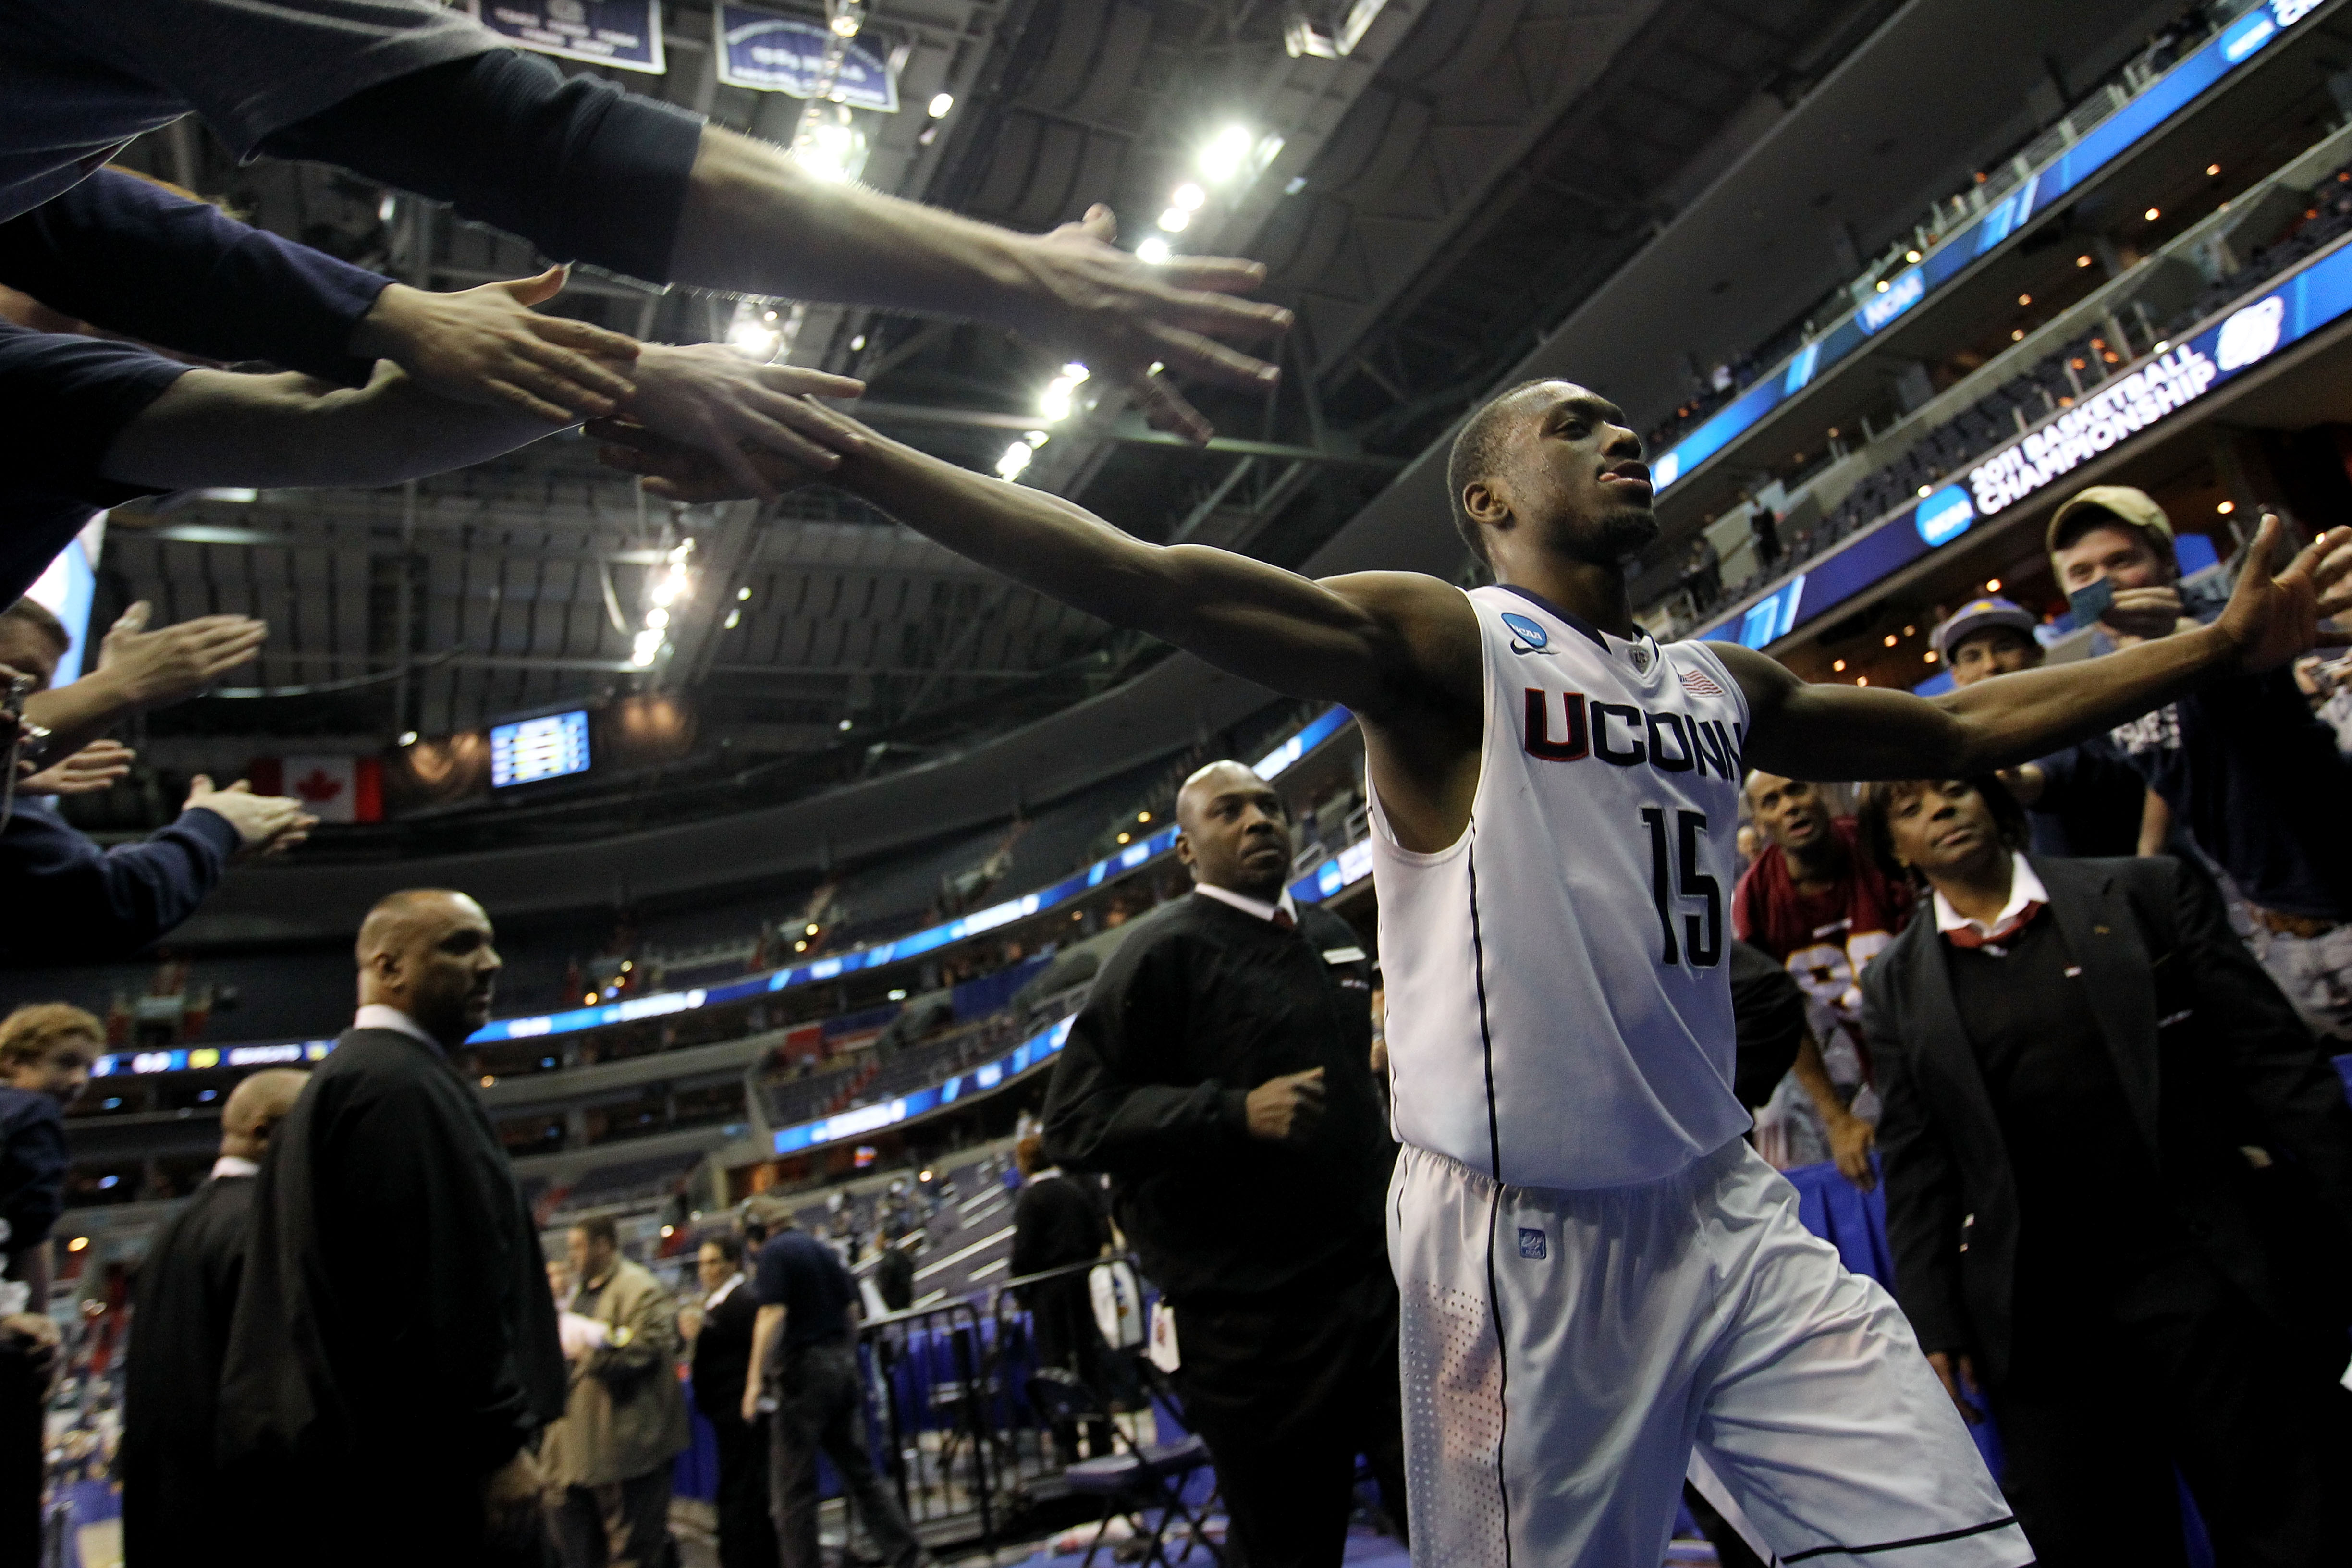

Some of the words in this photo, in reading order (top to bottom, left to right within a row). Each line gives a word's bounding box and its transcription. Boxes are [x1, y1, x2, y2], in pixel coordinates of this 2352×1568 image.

[1969, 444, 2025, 496] 2011
[2021, 343, 2206, 462] BASKETBALL
[1975, 359, 2217, 515] CHAMPIONSHIP
[1509, 623, 1543, 641] NCAA
[1524, 687, 1742, 782] UCONN
[1641, 808, 1722, 967] 15
